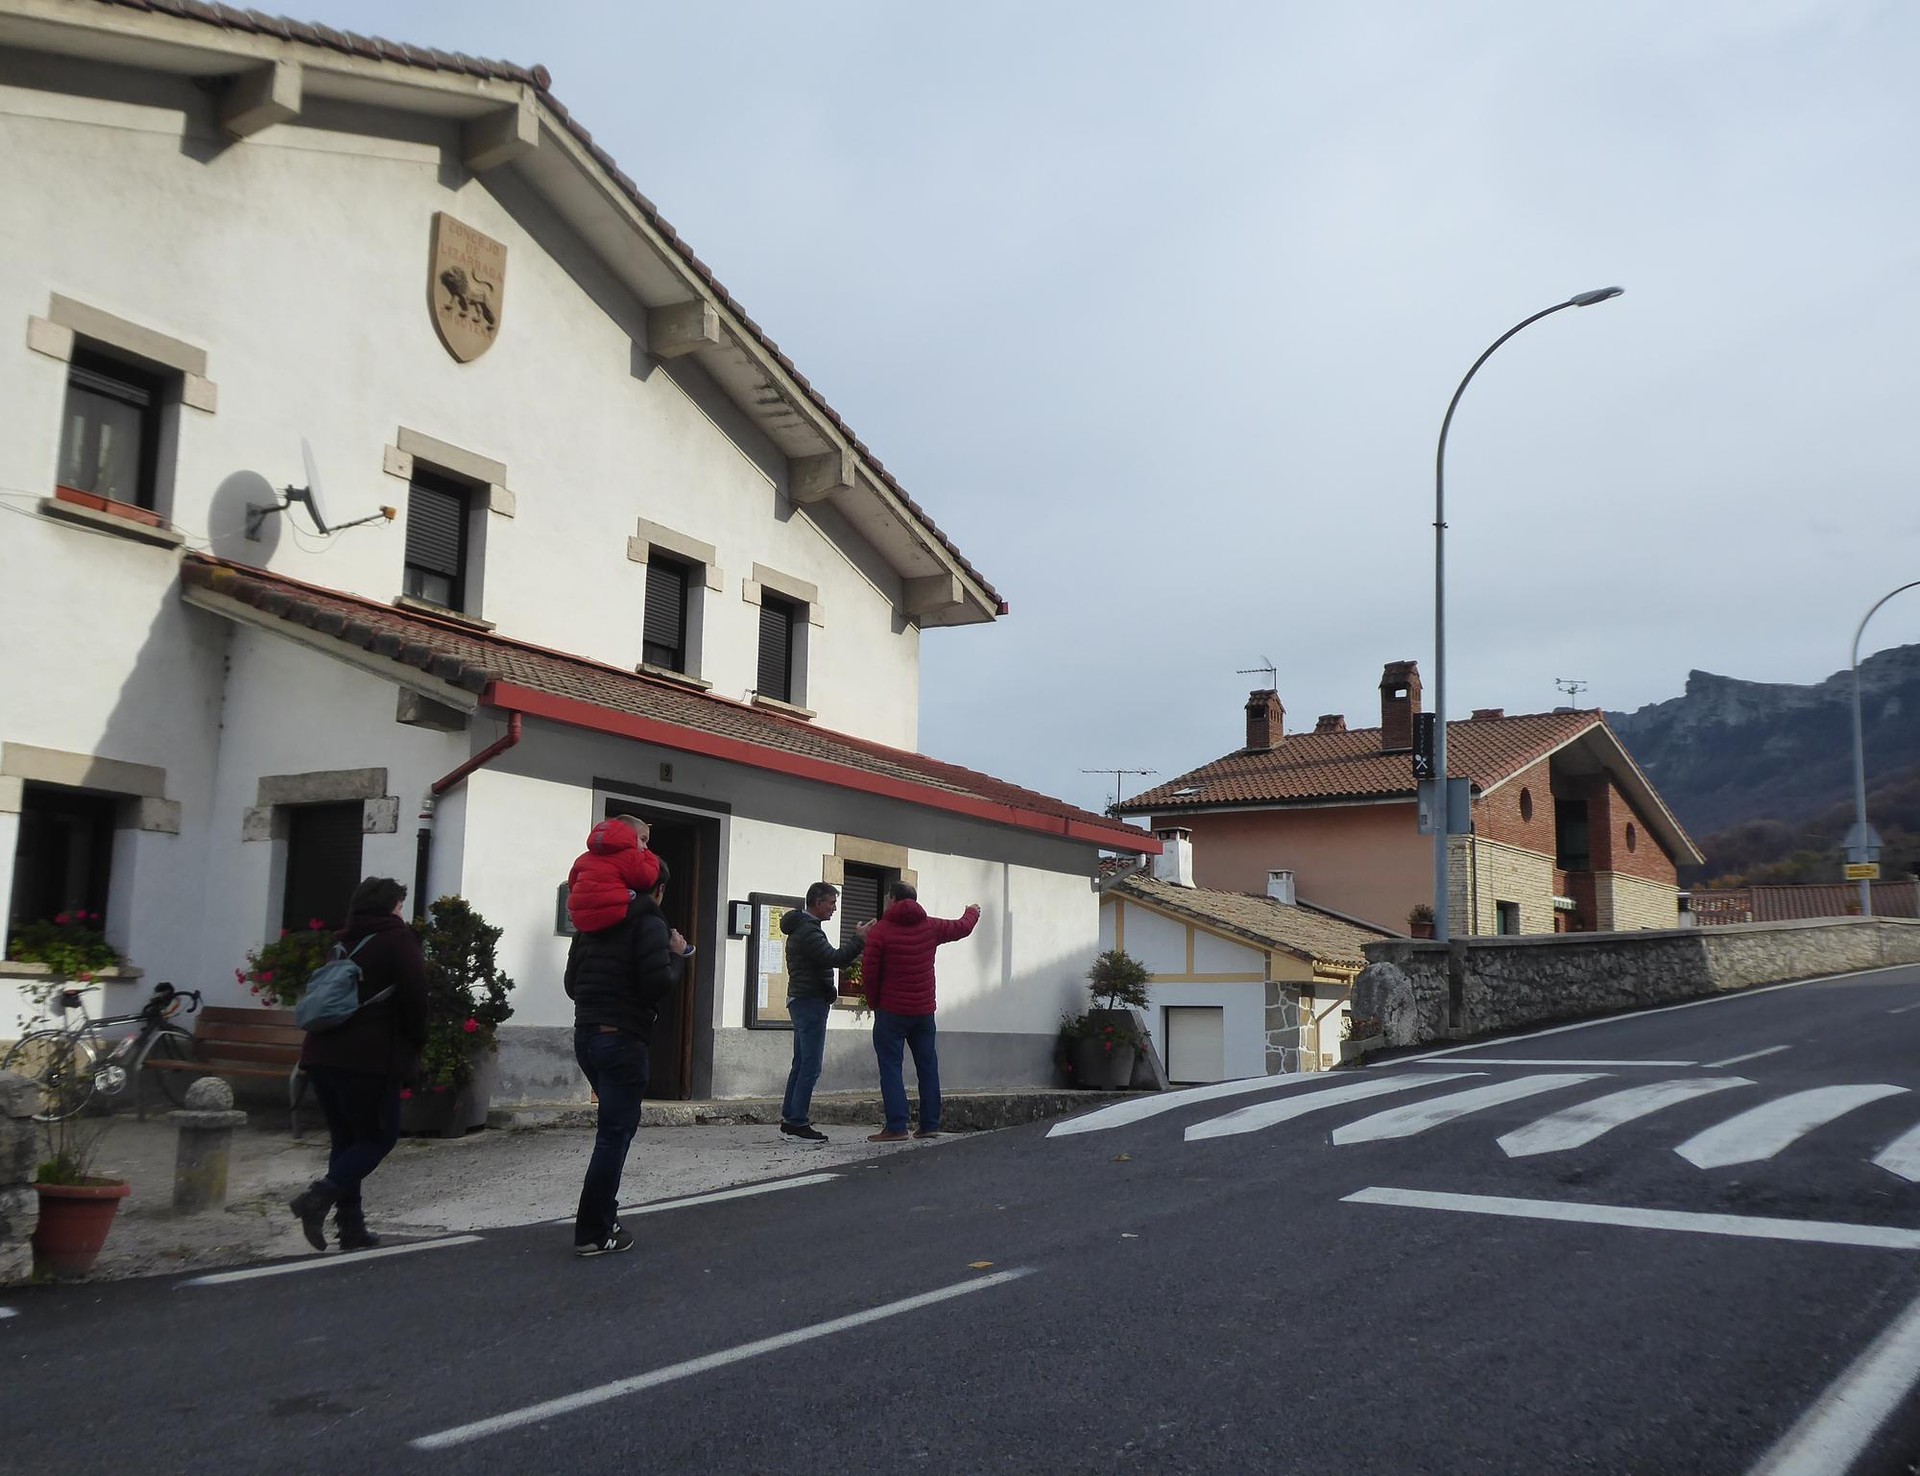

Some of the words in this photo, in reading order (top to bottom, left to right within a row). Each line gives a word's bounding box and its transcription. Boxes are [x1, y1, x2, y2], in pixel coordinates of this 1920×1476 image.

[449, 222, 500, 256] CONCEJO
[465, 242, 479, 255] DE
[604, 1239, 617, 1249] N
